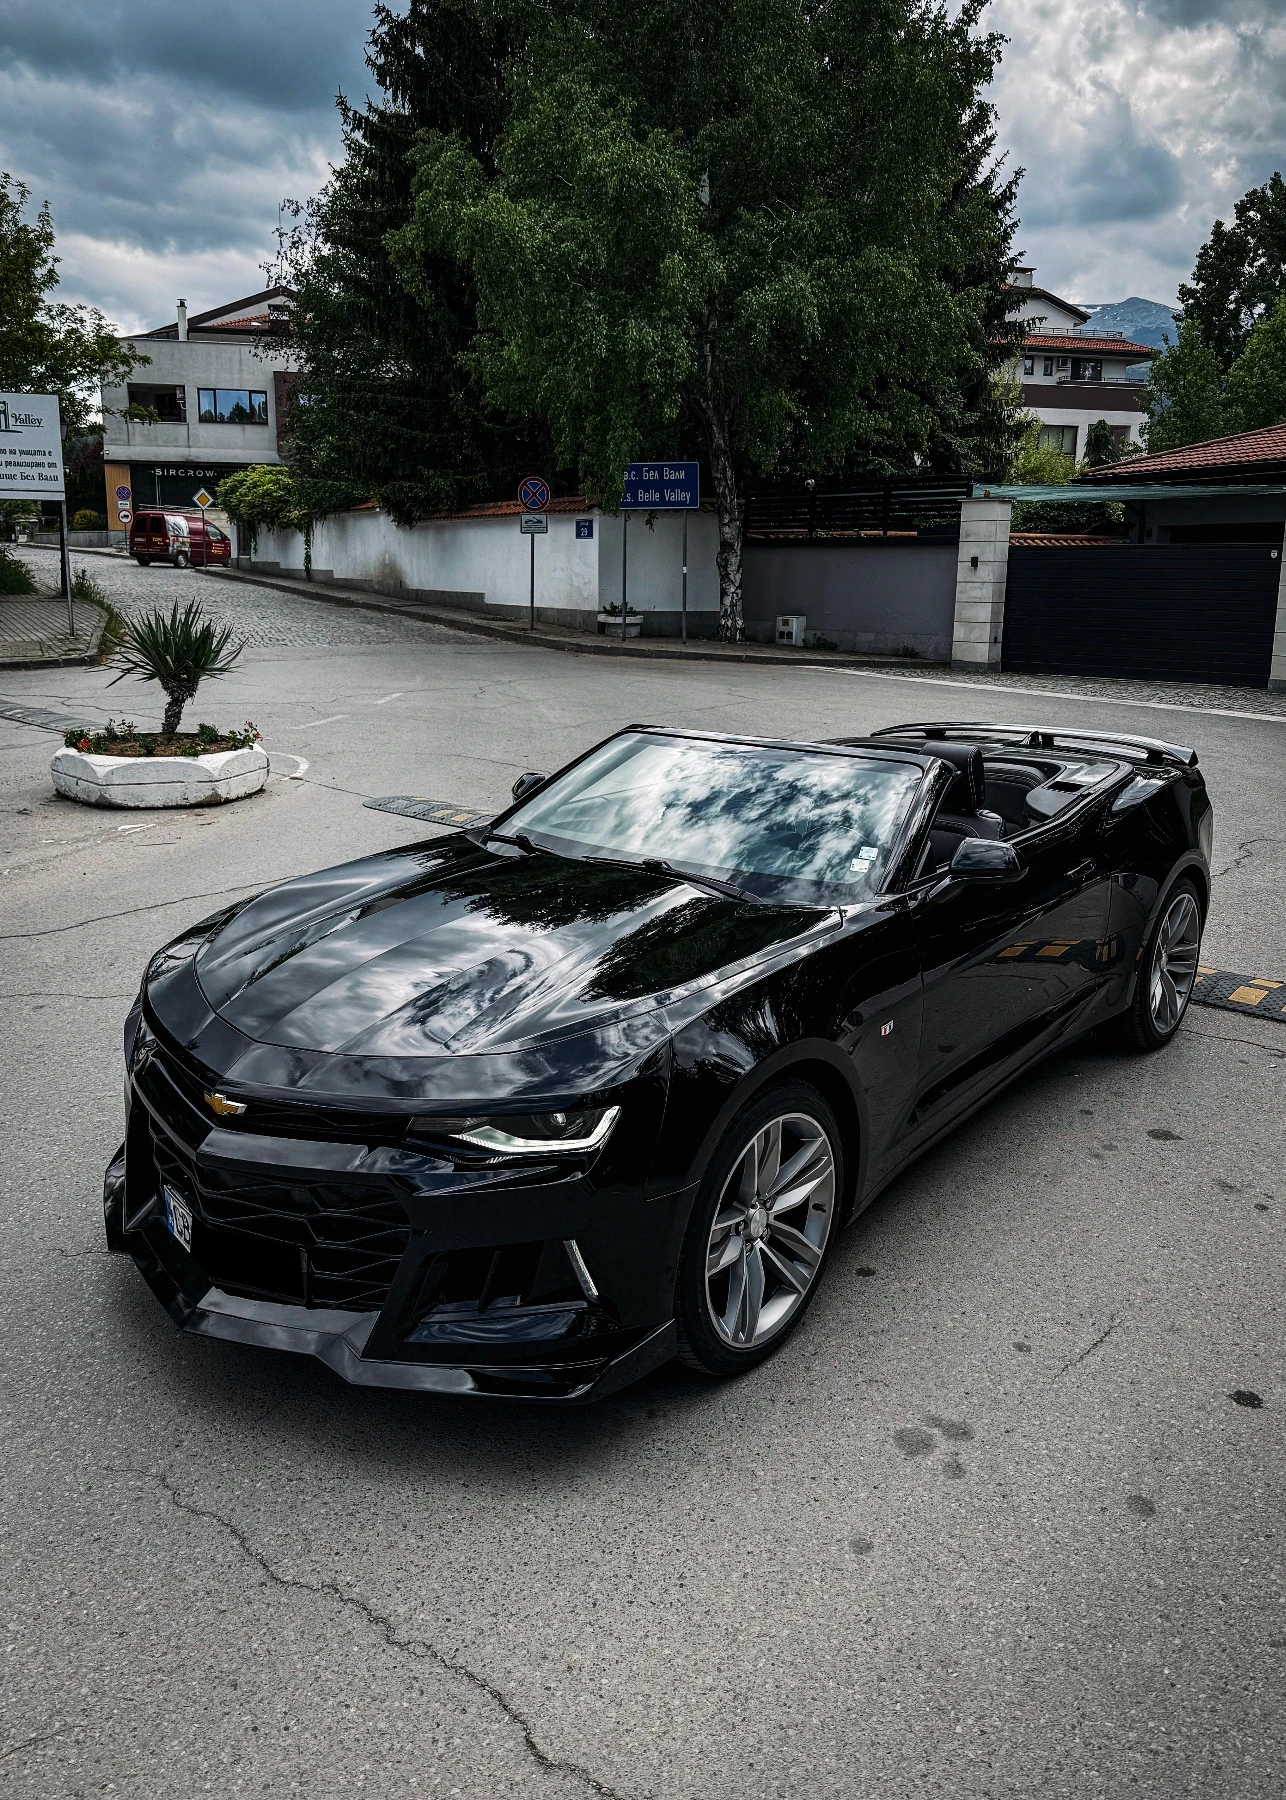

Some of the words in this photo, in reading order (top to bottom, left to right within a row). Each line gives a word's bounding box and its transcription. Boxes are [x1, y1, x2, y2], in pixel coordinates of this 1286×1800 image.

[11, 413, 43, 427] Valley
[9, 448, 16, 456] на
[18, 449, 46, 457] улицата
[5, 460, 46, 469] реализирано
[20, 472, 35, 481] Бел
[38, 473, 59, 481] Вали
[155, 468, 215, 477] SIRCROW
[642, 467, 659, 480] Бел
[663, 467, 685, 480] Вали
[638, 489, 660, 502] Belle
[664, 488, 691, 504] Valley
